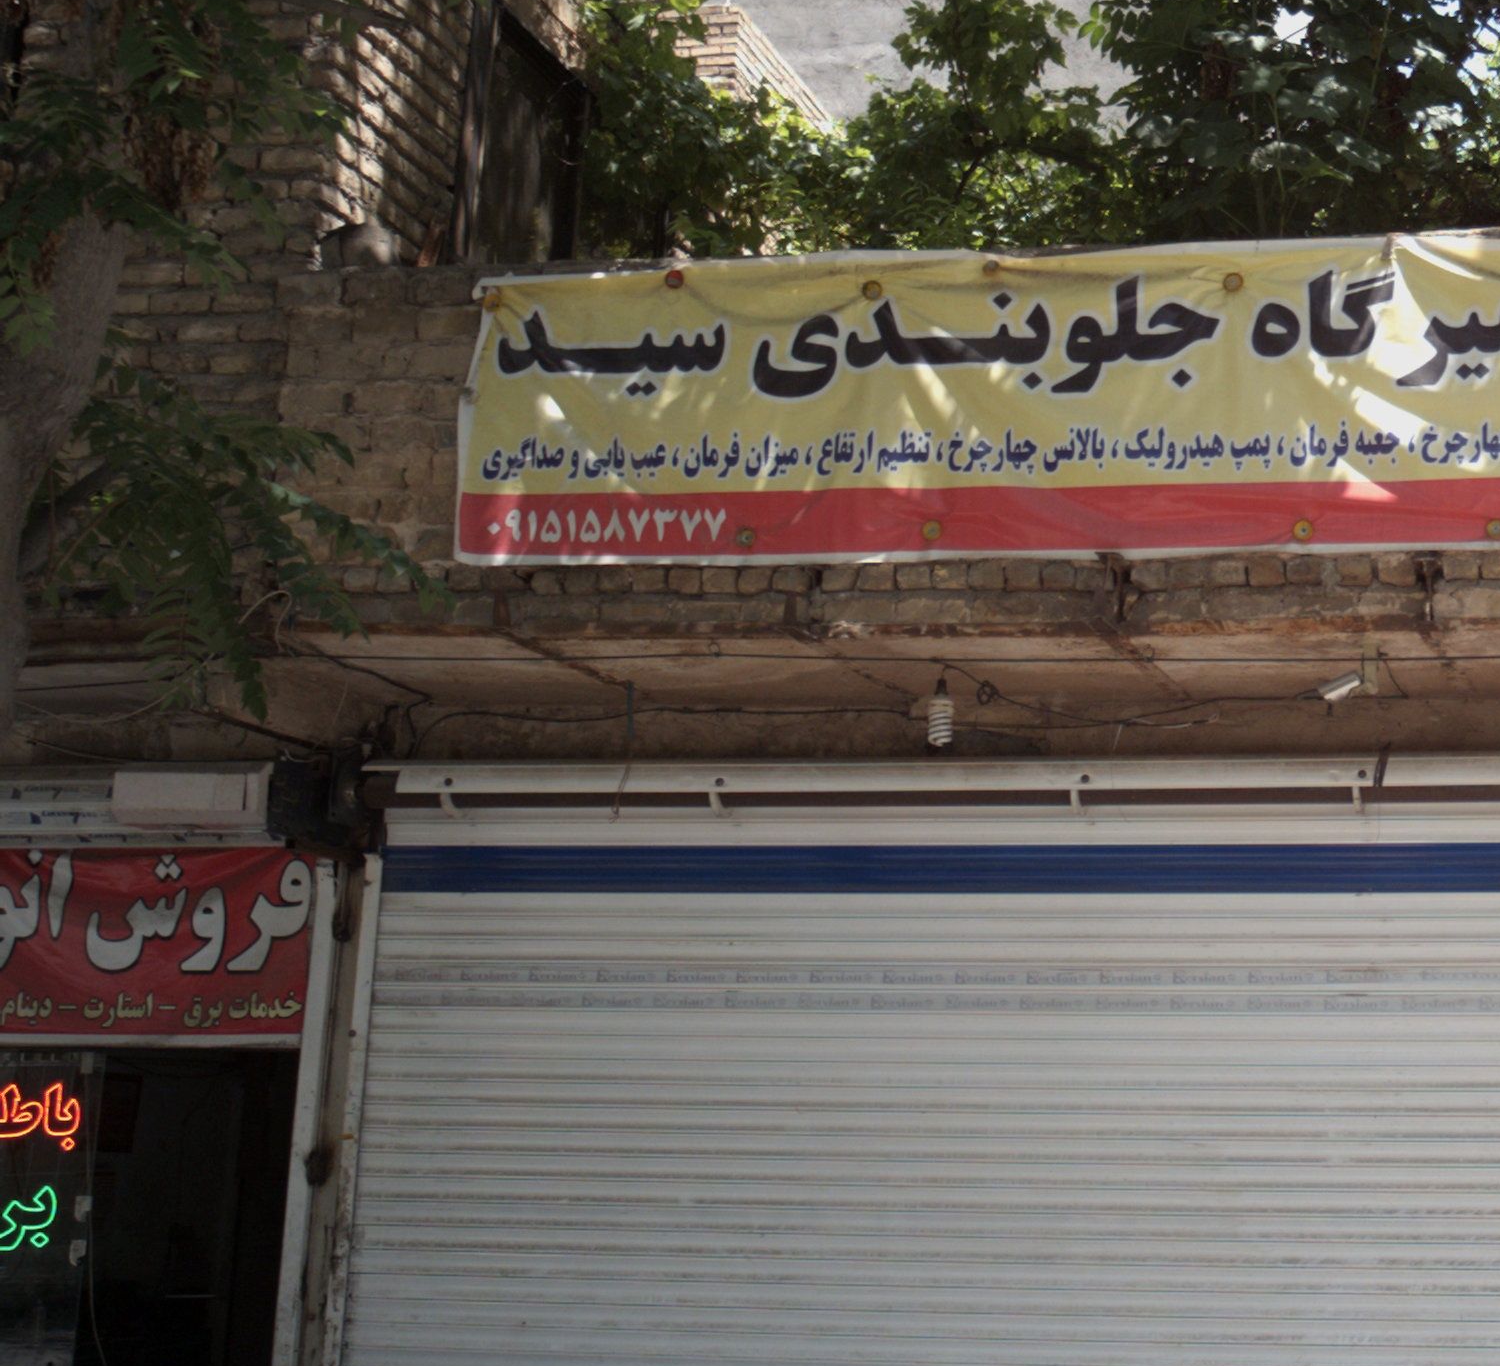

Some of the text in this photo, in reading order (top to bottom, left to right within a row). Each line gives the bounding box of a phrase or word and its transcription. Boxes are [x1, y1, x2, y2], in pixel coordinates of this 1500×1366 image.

[496, 305, 728, 397] سید
[751, 274, 1221, 399] جلوبندی
[481, 436, 565, 480] صداگیری
[567, 449, 580, 479] و
[744, 433, 798, 478] میزان
[876, 429, 933, 473] تنظیم
[1043, 427, 1106, 473] بالانس
[1230, 431, 1271, 471] پمپ
[1355, 428, 1401, 466] جعبه
[486, 507, 727, 543] ۰۹۱۵۱۵۸۷۳۷۷
[85, 853, 312, 973] فروش
[1, 991, 52, 1026] دینام
[82, 991, 154, 1028] استارت
[182, 996, 224, 1028] برق
[227, 991, 303, 1020] خدمات
[0, 1082, 81, 1152] باط
